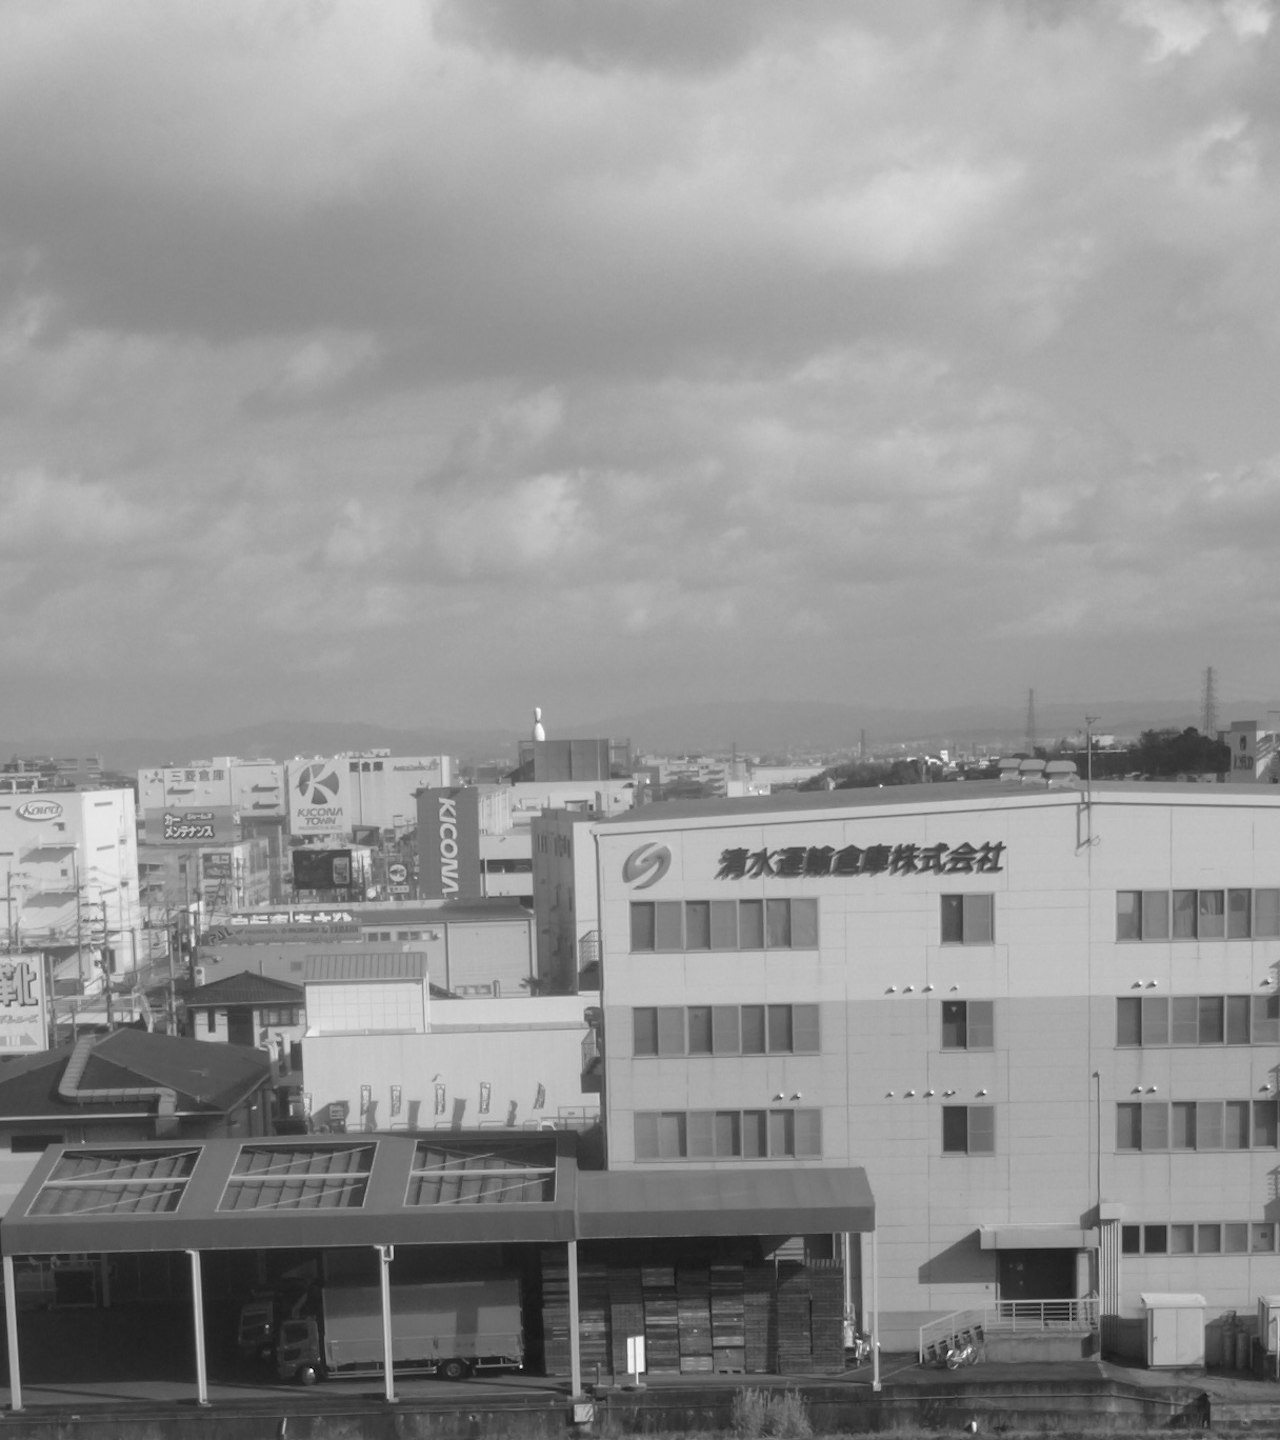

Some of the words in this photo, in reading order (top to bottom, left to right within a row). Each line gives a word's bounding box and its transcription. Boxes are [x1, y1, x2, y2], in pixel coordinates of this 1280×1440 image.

[297, 807, 343, 817] KICONA
[304, 817, 336, 825] TOWN
[164, 825, 214, 838] メンテナンス
[438, 797, 459, 894] KICONA
[714, 841, 1007, 880] 清水運輸倉庫株式会社
